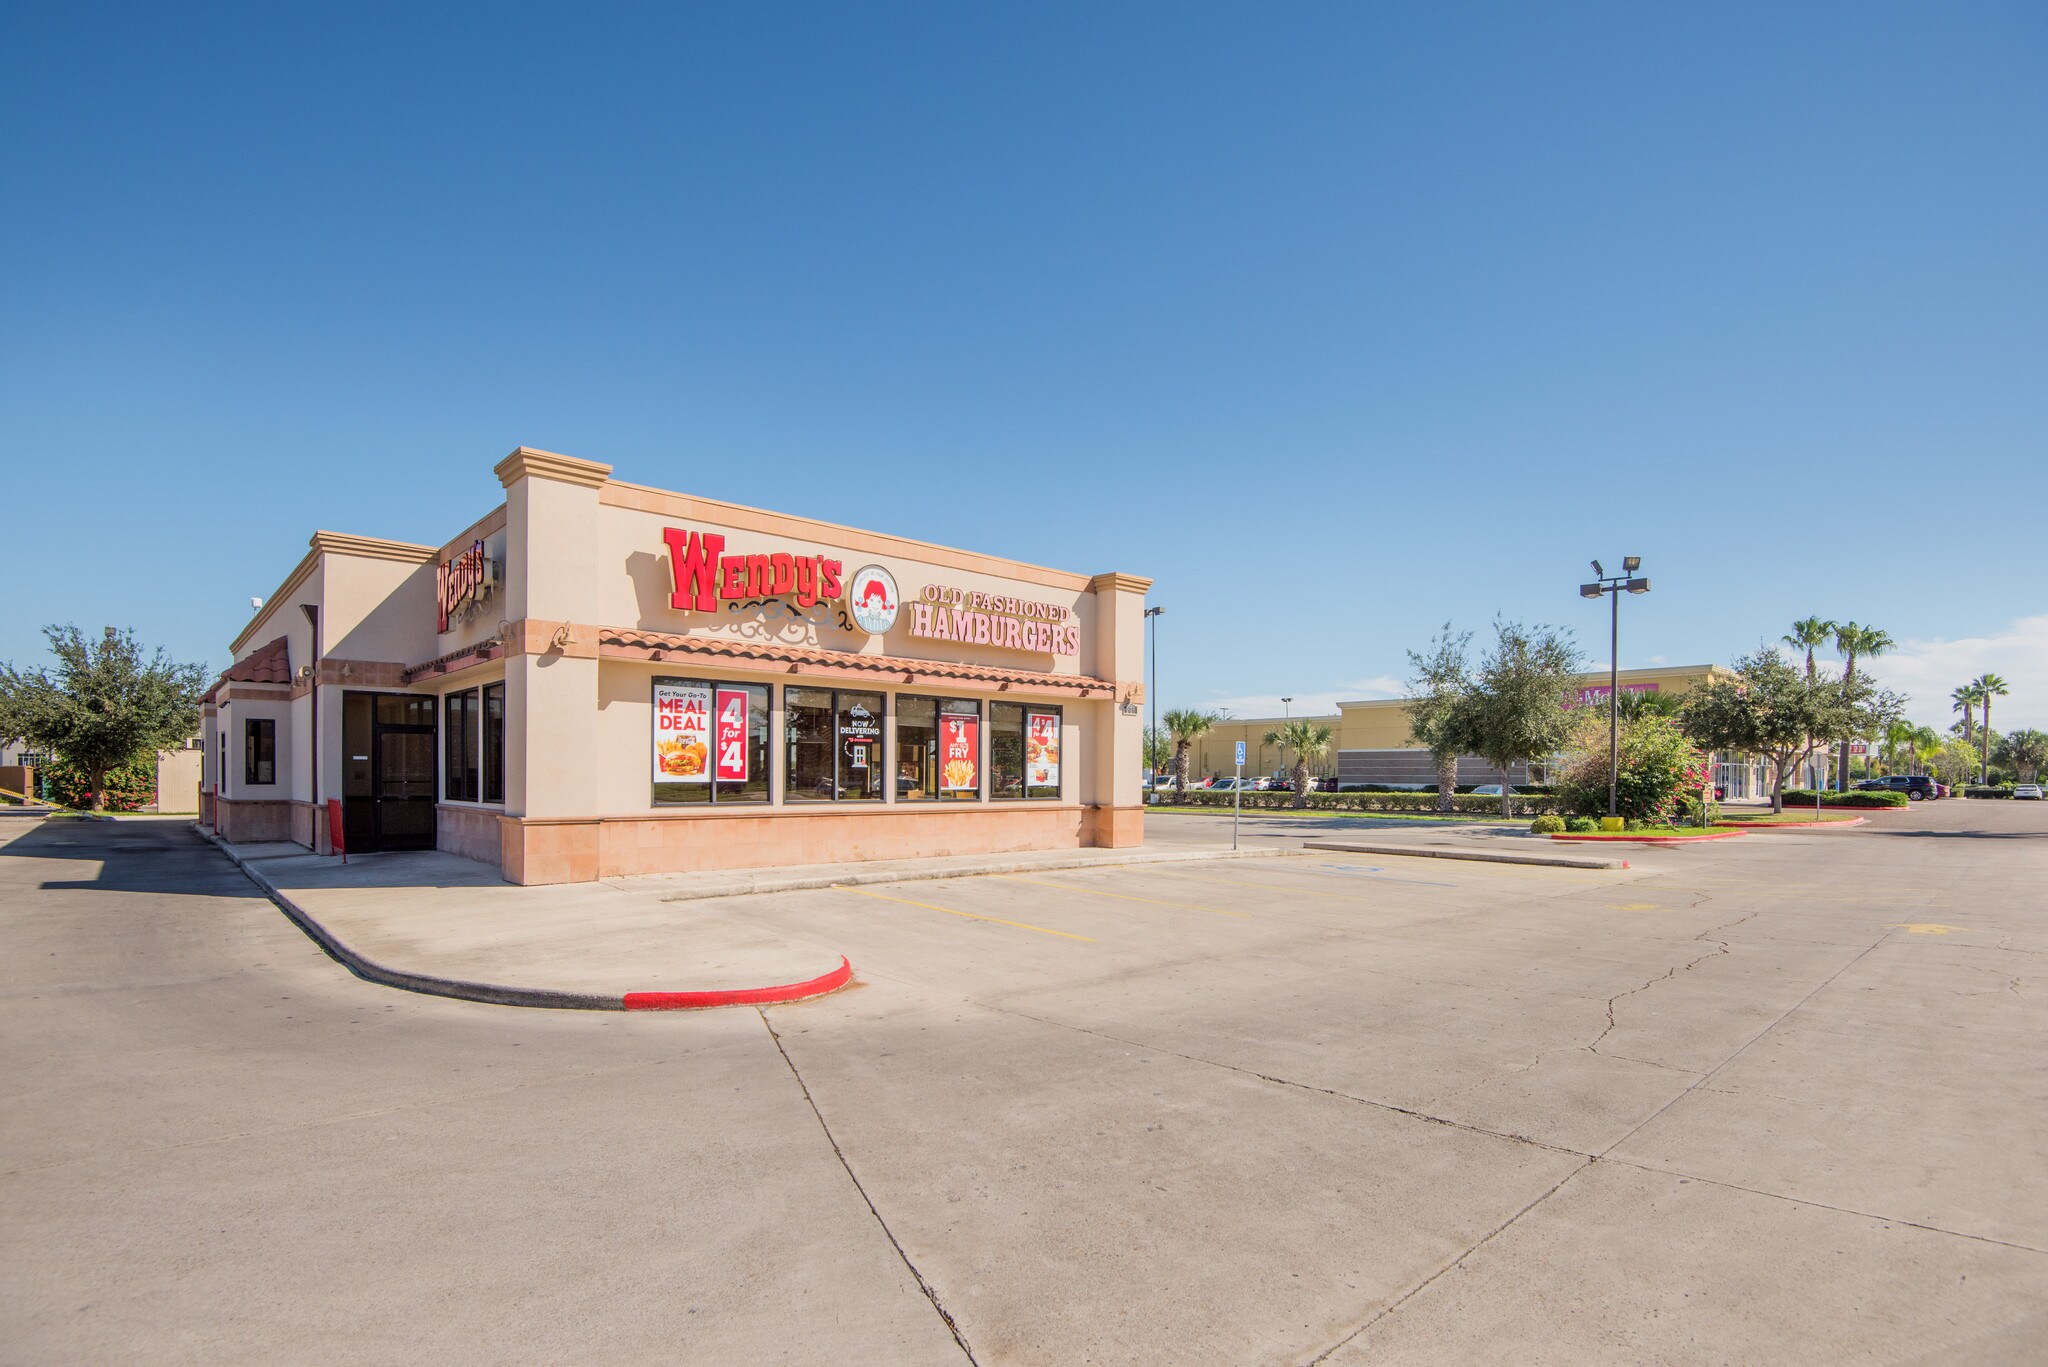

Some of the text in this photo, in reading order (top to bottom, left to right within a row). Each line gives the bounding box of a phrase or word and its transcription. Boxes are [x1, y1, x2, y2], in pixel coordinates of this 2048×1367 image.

[924, 584, 964, 605] OLD
[971, 591, 1070, 622] FASHIONED
[913, 603, 1080, 656] HAMBURGERS
[659, 698, 707, 715] MEAL
[720, 698, 743, 729] 4
[660, 715, 706, 731] DEAL
[840, 727, 880, 735] DELIVERING
[1032, 717, 1041, 731] 4
[721, 727, 740, 740] for
[949, 748, 969, 759] FRY
